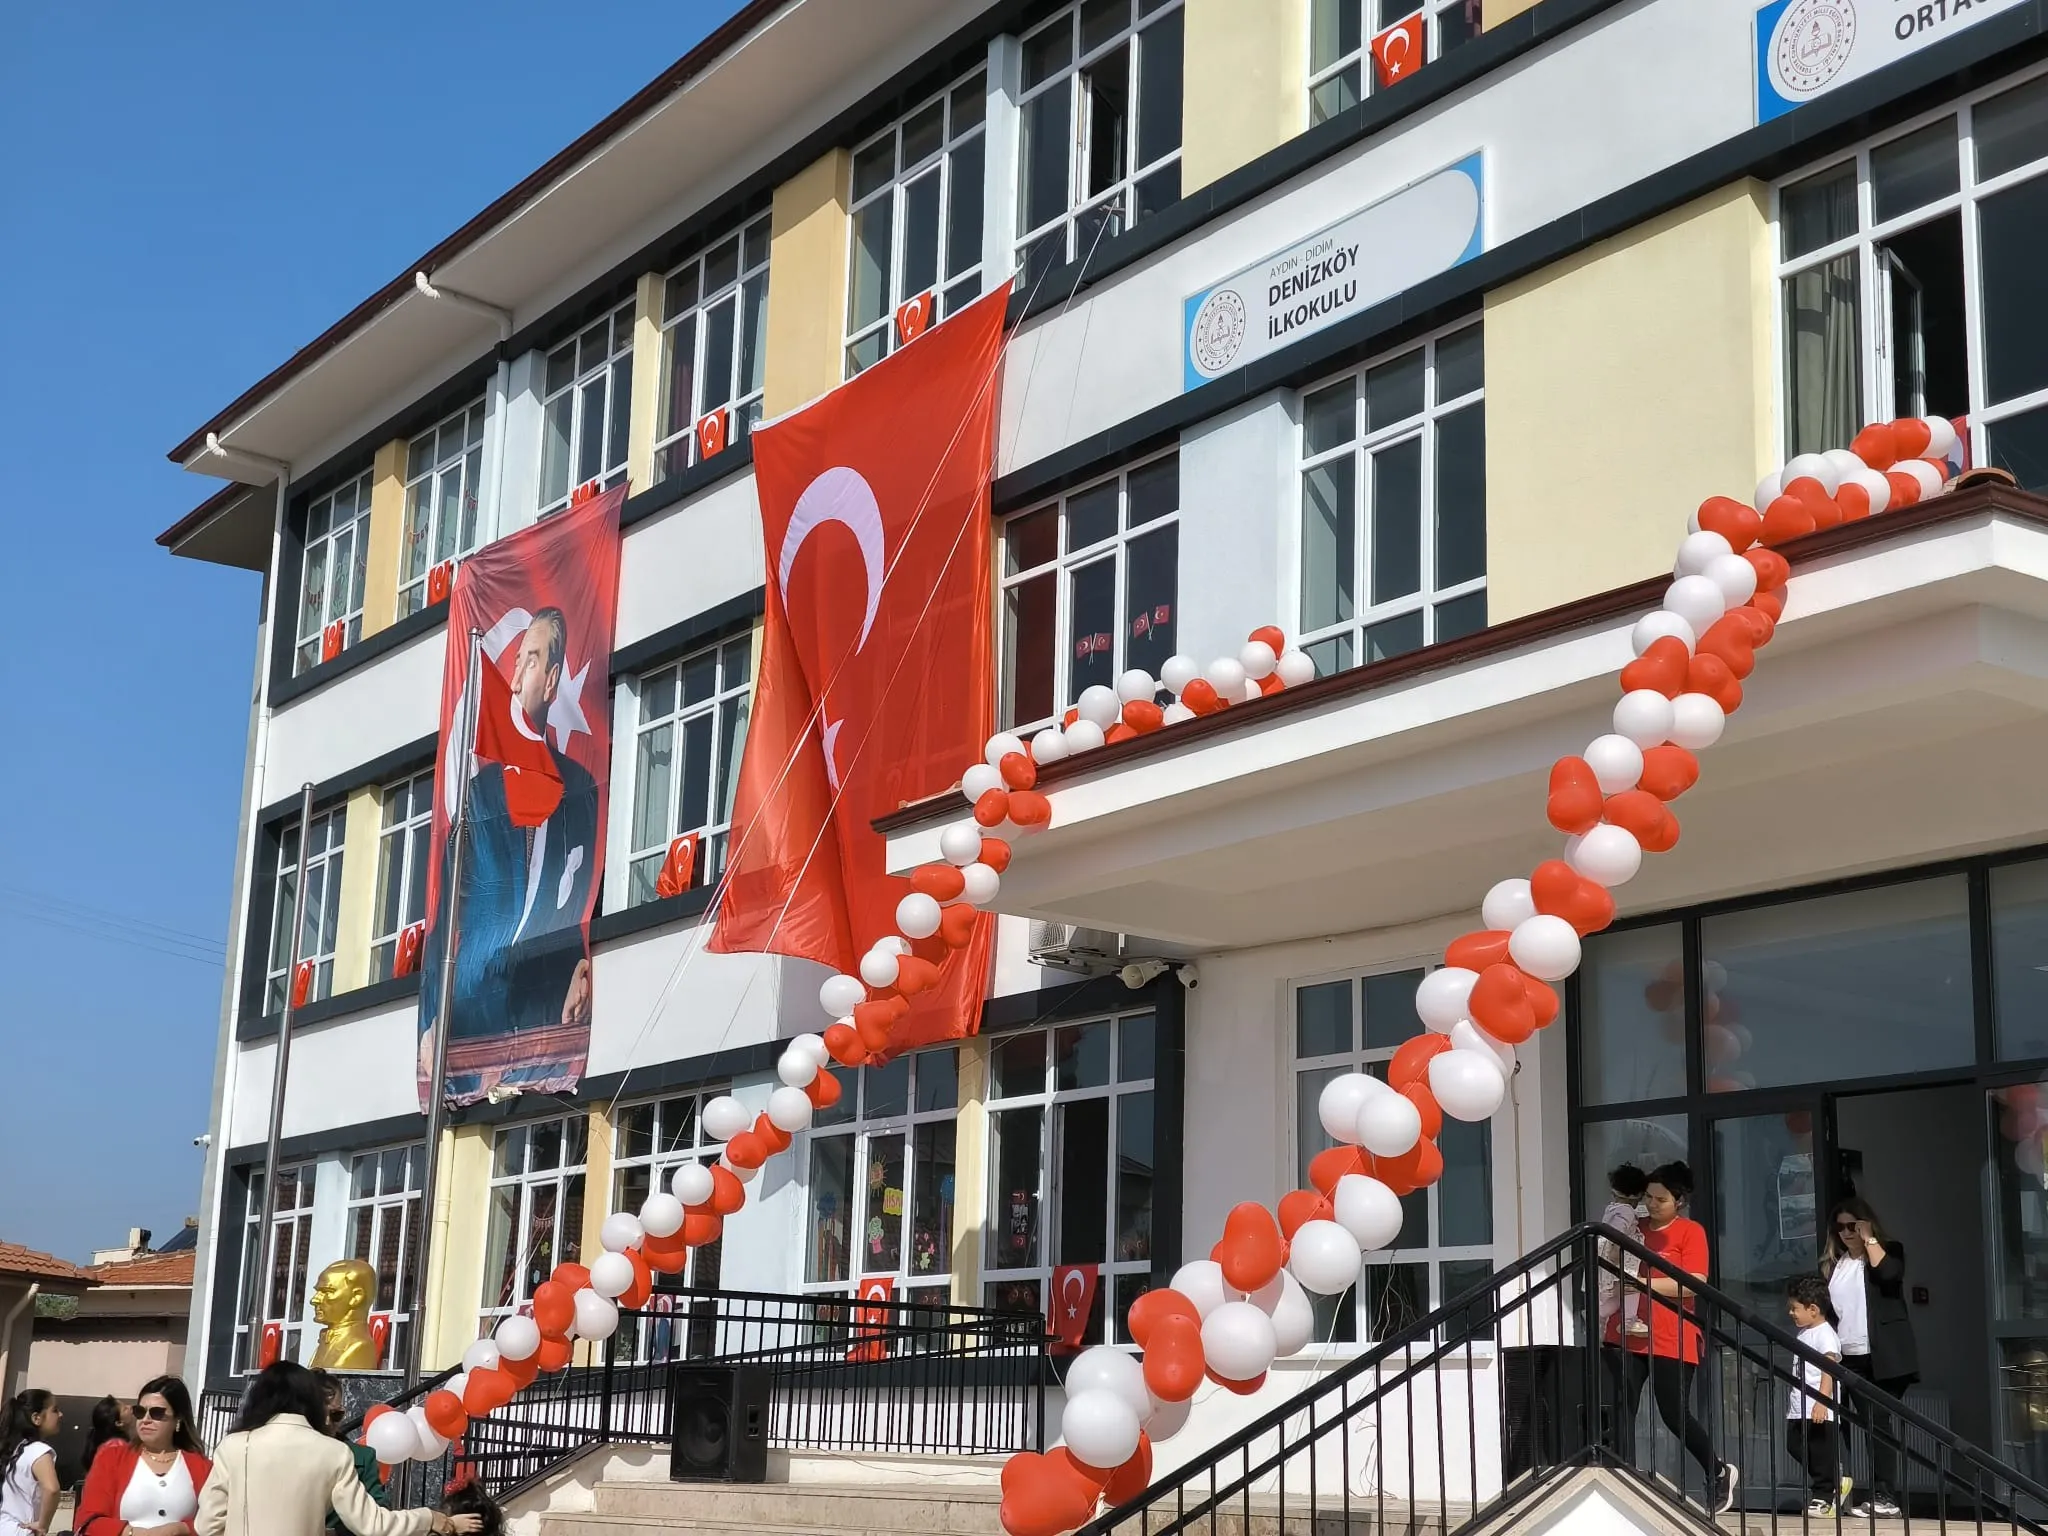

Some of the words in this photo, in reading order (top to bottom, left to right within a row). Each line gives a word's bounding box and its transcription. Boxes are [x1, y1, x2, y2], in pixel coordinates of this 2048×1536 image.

[1894, 0, 1989, 40] ORTA
[1268, 243, 1359, 307] DENİZKÖY
[1269, 256, 1298, 279] AYDIN
[1305, 238, 1333, 262] DİDİM
[1268, 279, 1357, 340] İLKOKULU
